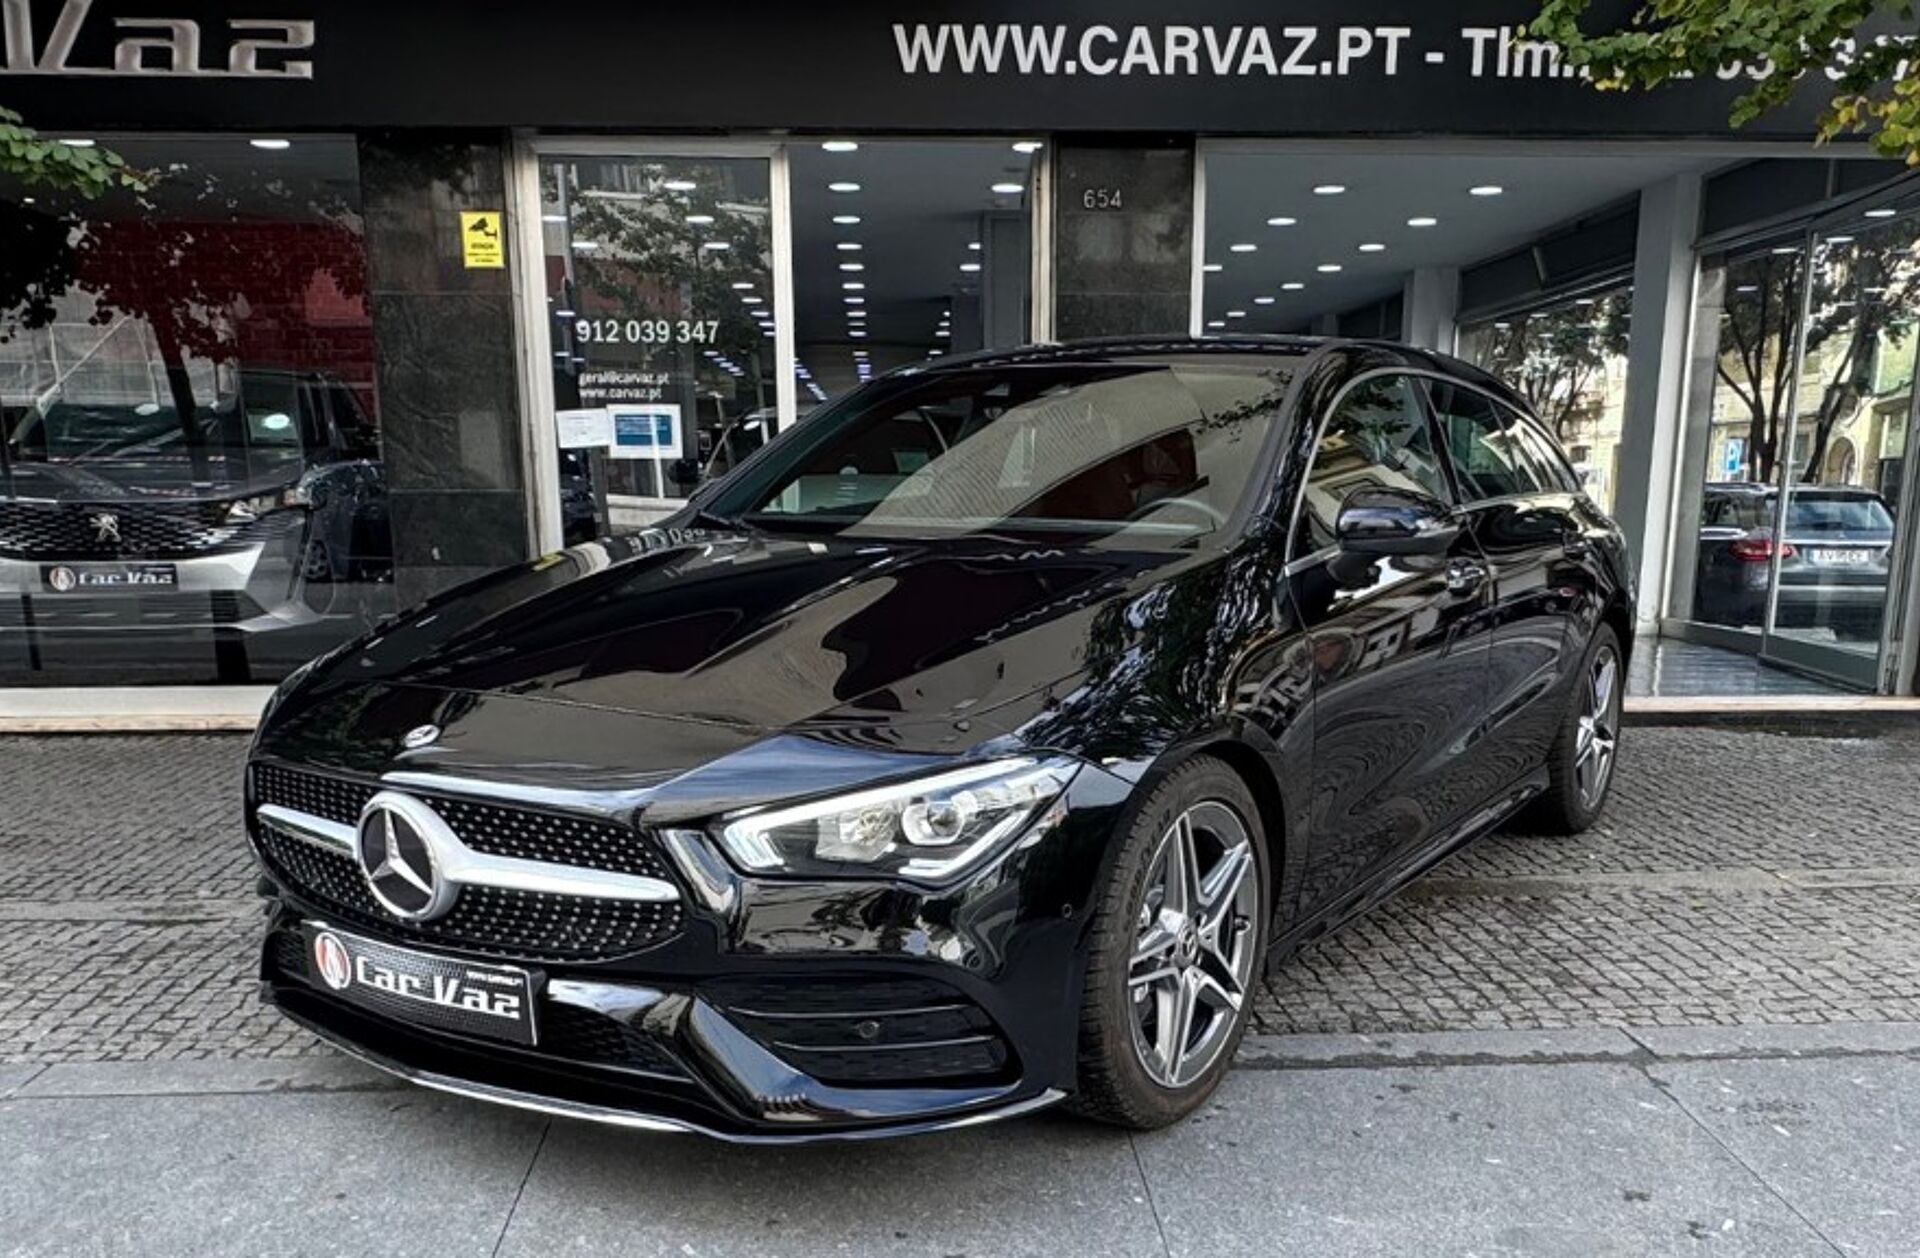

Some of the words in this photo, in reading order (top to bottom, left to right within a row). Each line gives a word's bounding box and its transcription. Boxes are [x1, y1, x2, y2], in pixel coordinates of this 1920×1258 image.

[892, 23, 1411, 76] WWW.CARVAZ.PT
[1083, 189, 1122, 209] 654
[575, 319, 620, 343] 912
[625, 319, 671, 343] 039
[675, 319, 720, 344] 347
[578, 370, 670, 387] geral@carvaz.pt
[578, 387, 663, 401] www.carvaz.pt
[355, 955, 422, 997] Car
[432, 975, 521, 1020] Vaz
